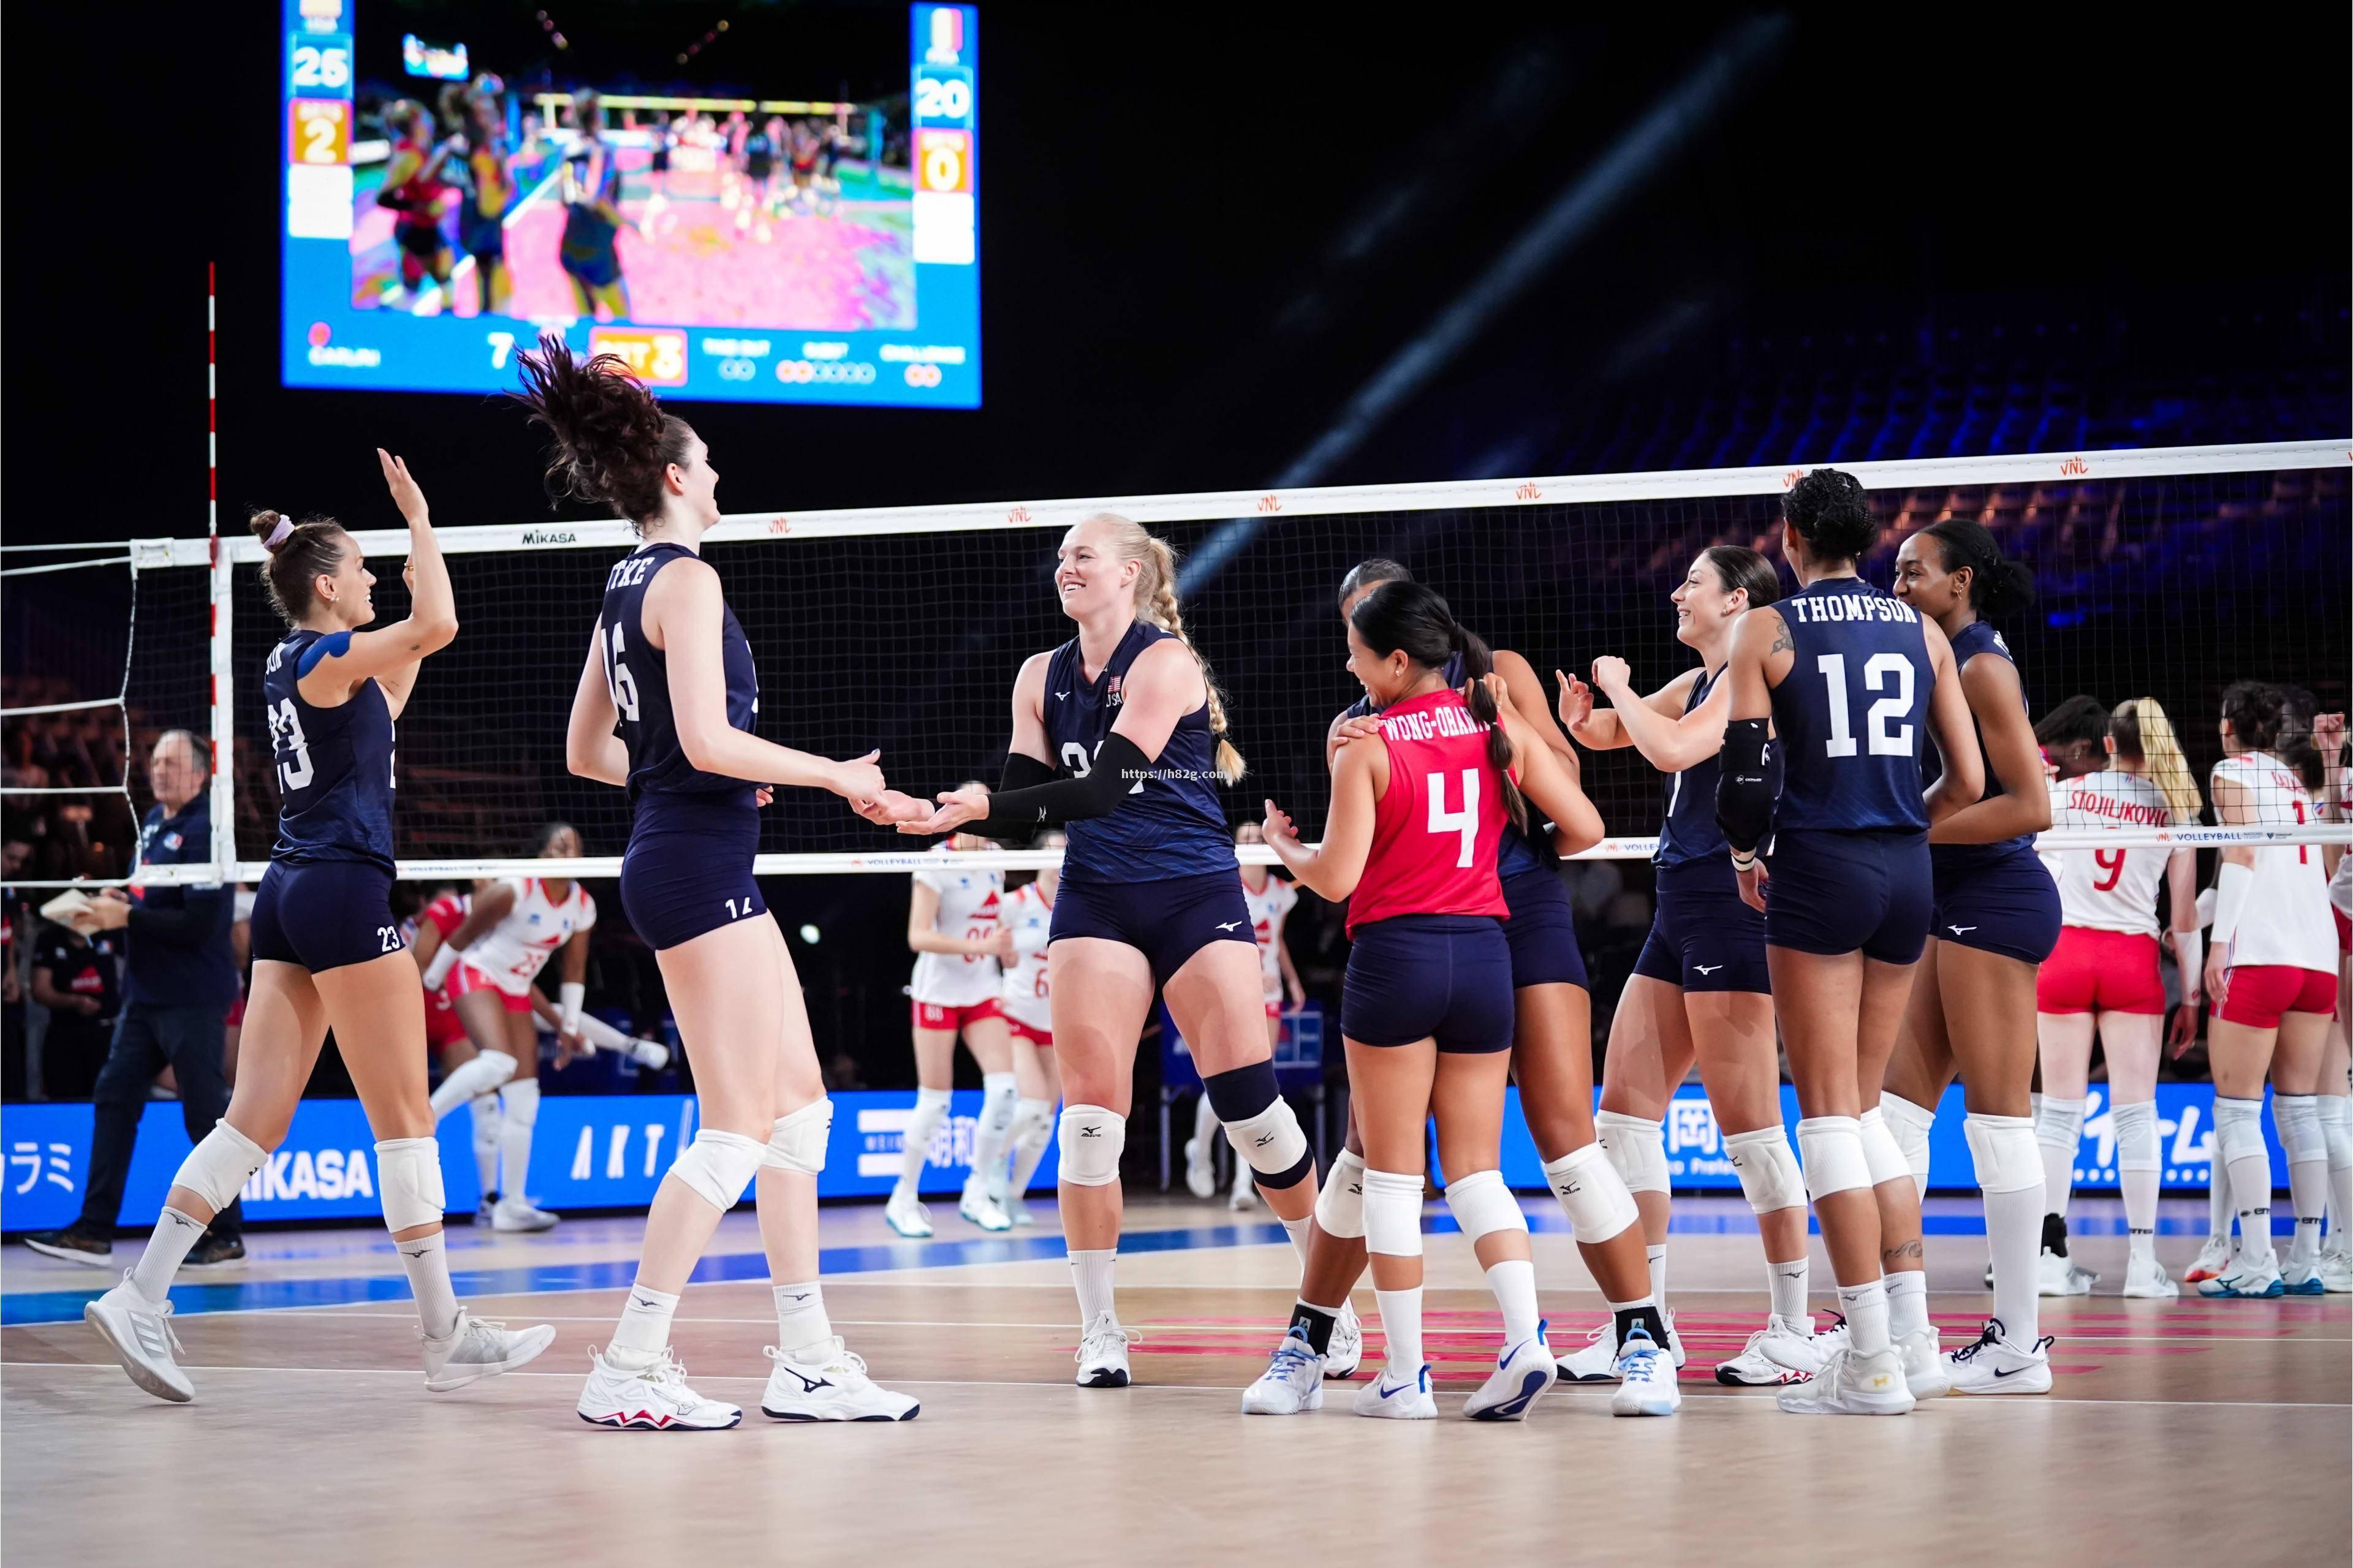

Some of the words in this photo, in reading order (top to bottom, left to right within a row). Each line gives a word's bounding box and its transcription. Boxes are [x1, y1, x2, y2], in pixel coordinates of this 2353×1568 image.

[294, 47, 348, 88] 25
[915, 78, 971, 118] 20
[304, 119, 336, 164] 2
[926, 147, 960, 192] 0
[2061, 456, 2088, 475] VNL
[1257, 494, 1282, 512] VNL
[1516, 482, 1542, 500] VNL
[769, 517, 792, 534] VNL
[1008, 506, 1032, 523] VNL
[1792, 595, 1917, 623] THOMPSON
[1818, 653, 1914, 758] 12
[1427, 768, 1479, 868] 4
[2177, 832, 2242, 841] VOLLEYBALL
[2094, 826, 2126, 892] 9
[377, 925, 401, 952] 23
[1, 1142, 74, 1195] ラミ
